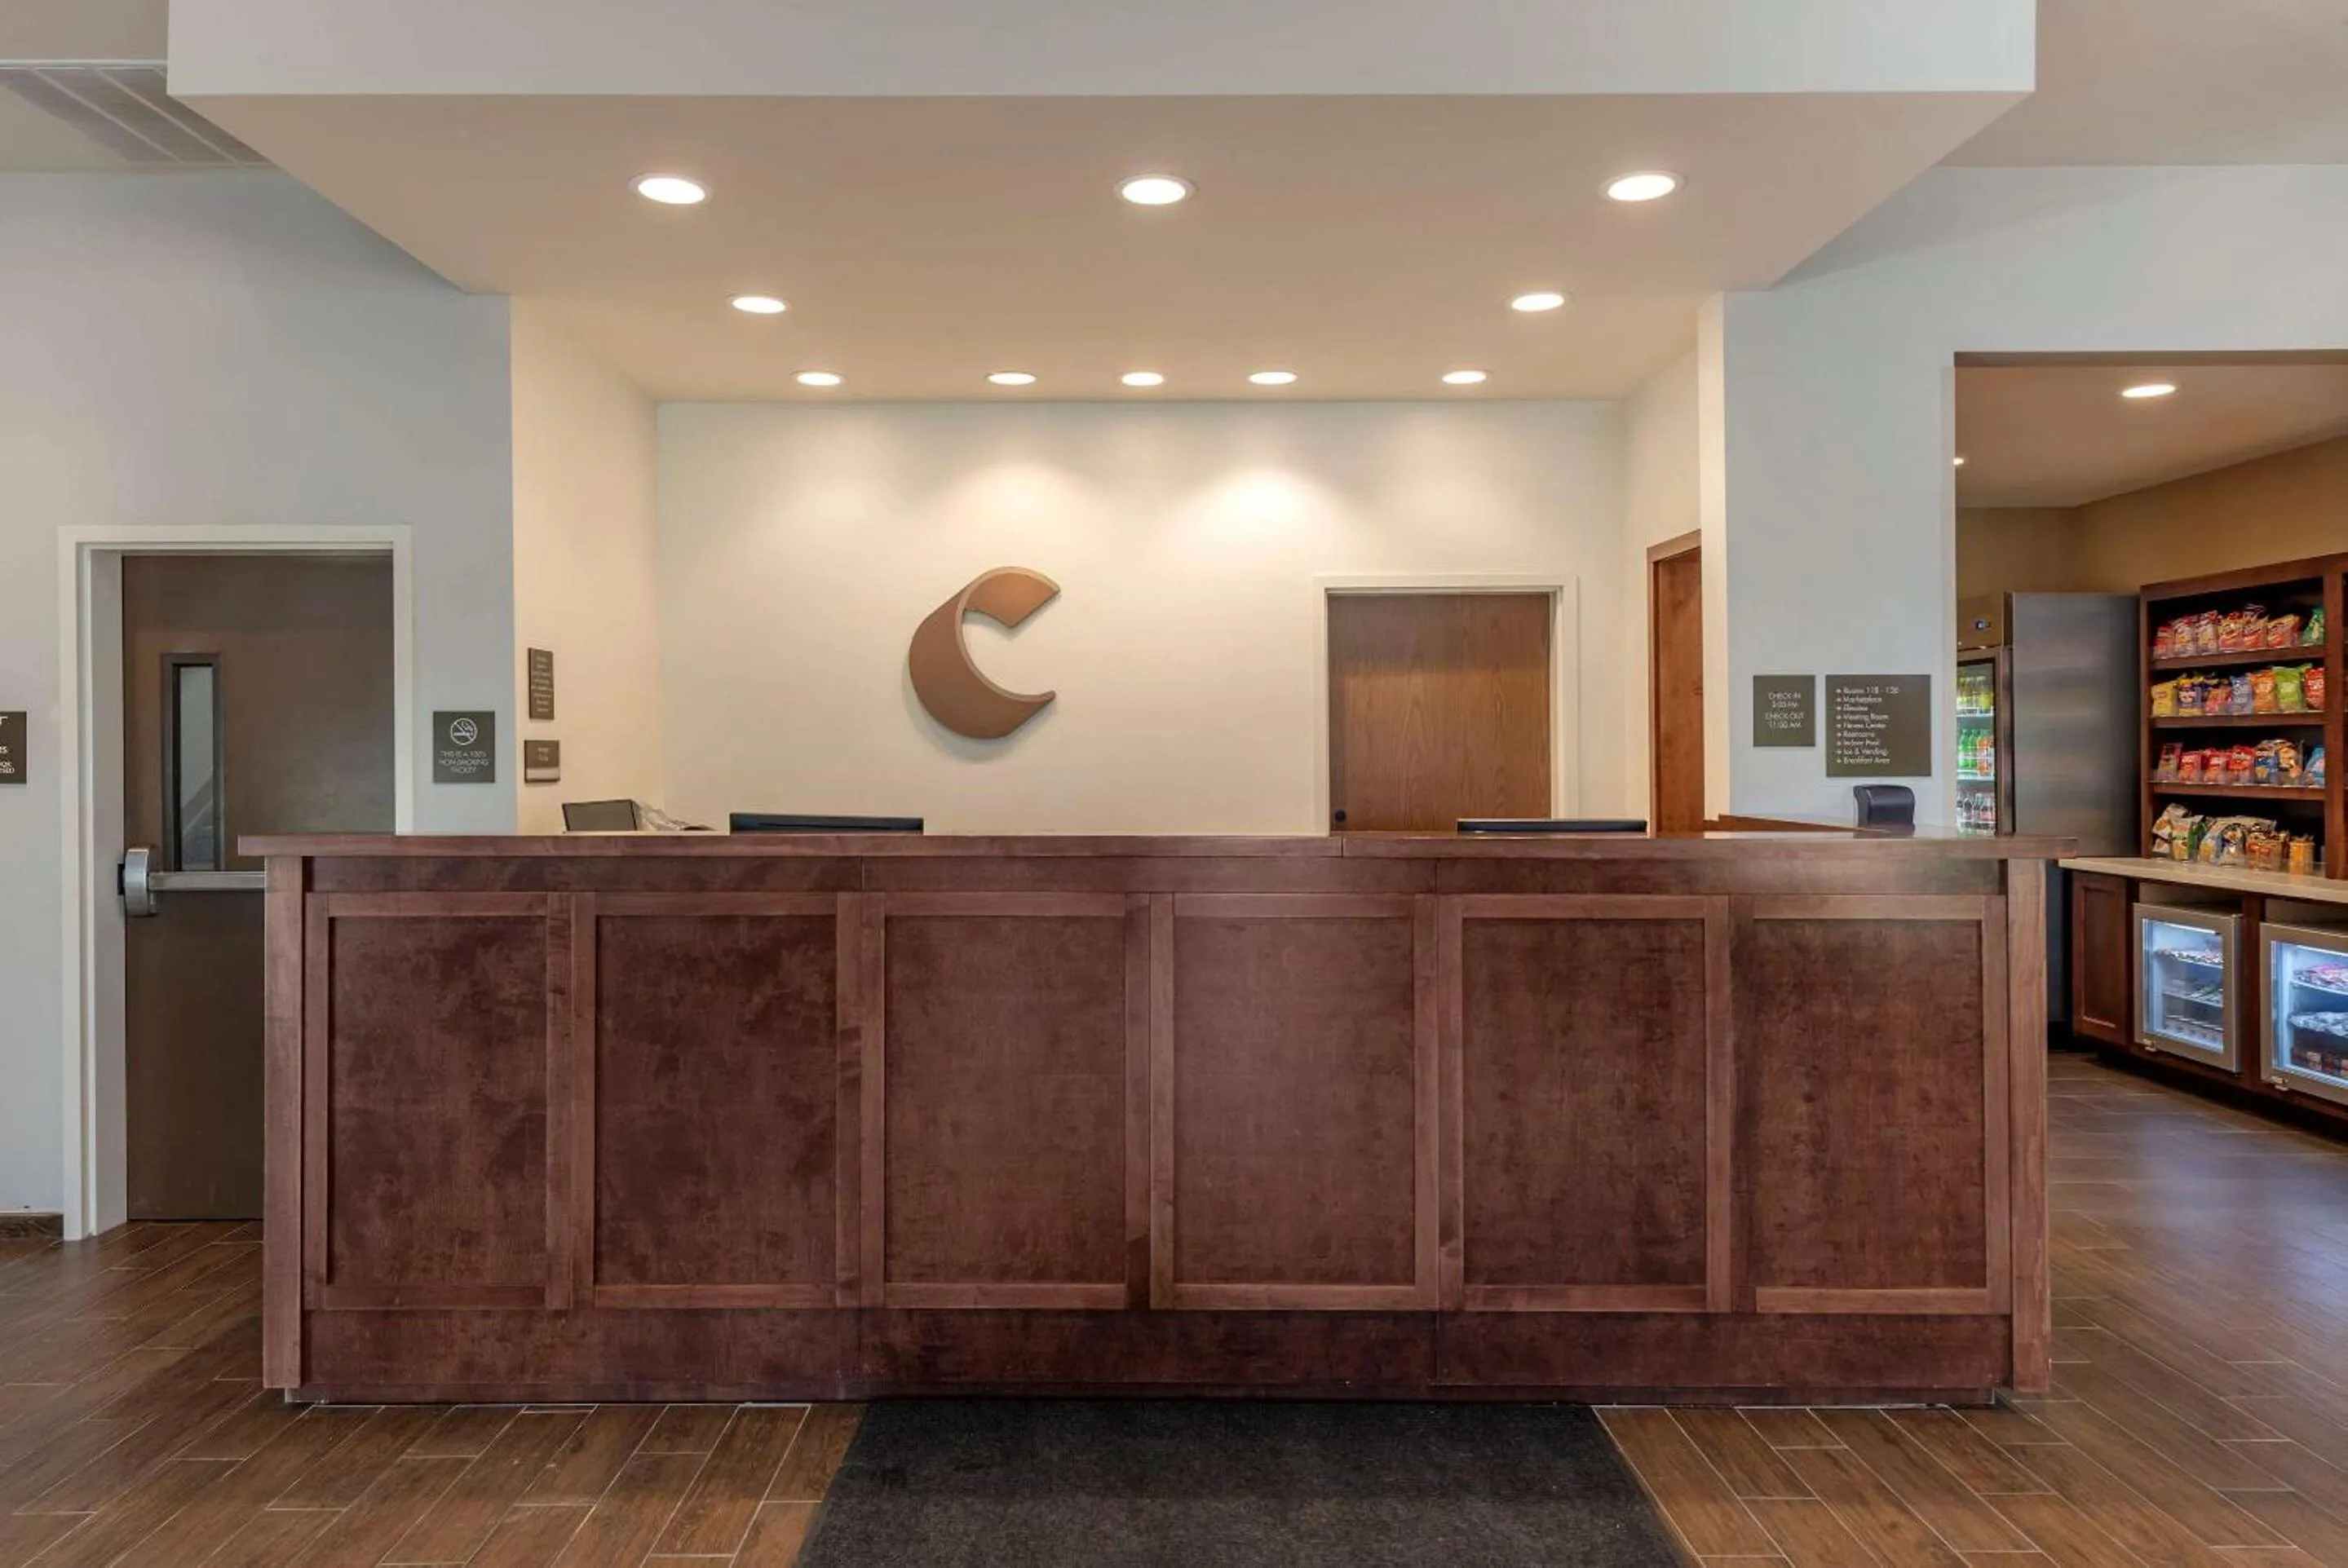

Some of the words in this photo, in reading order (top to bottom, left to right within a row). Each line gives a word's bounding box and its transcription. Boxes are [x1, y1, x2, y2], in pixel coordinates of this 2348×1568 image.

[1765, 712, 1789, 720] CHECK
[1843, 757, 1874, 765] Breakfast
[1874, 757, 1890, 765] Area
